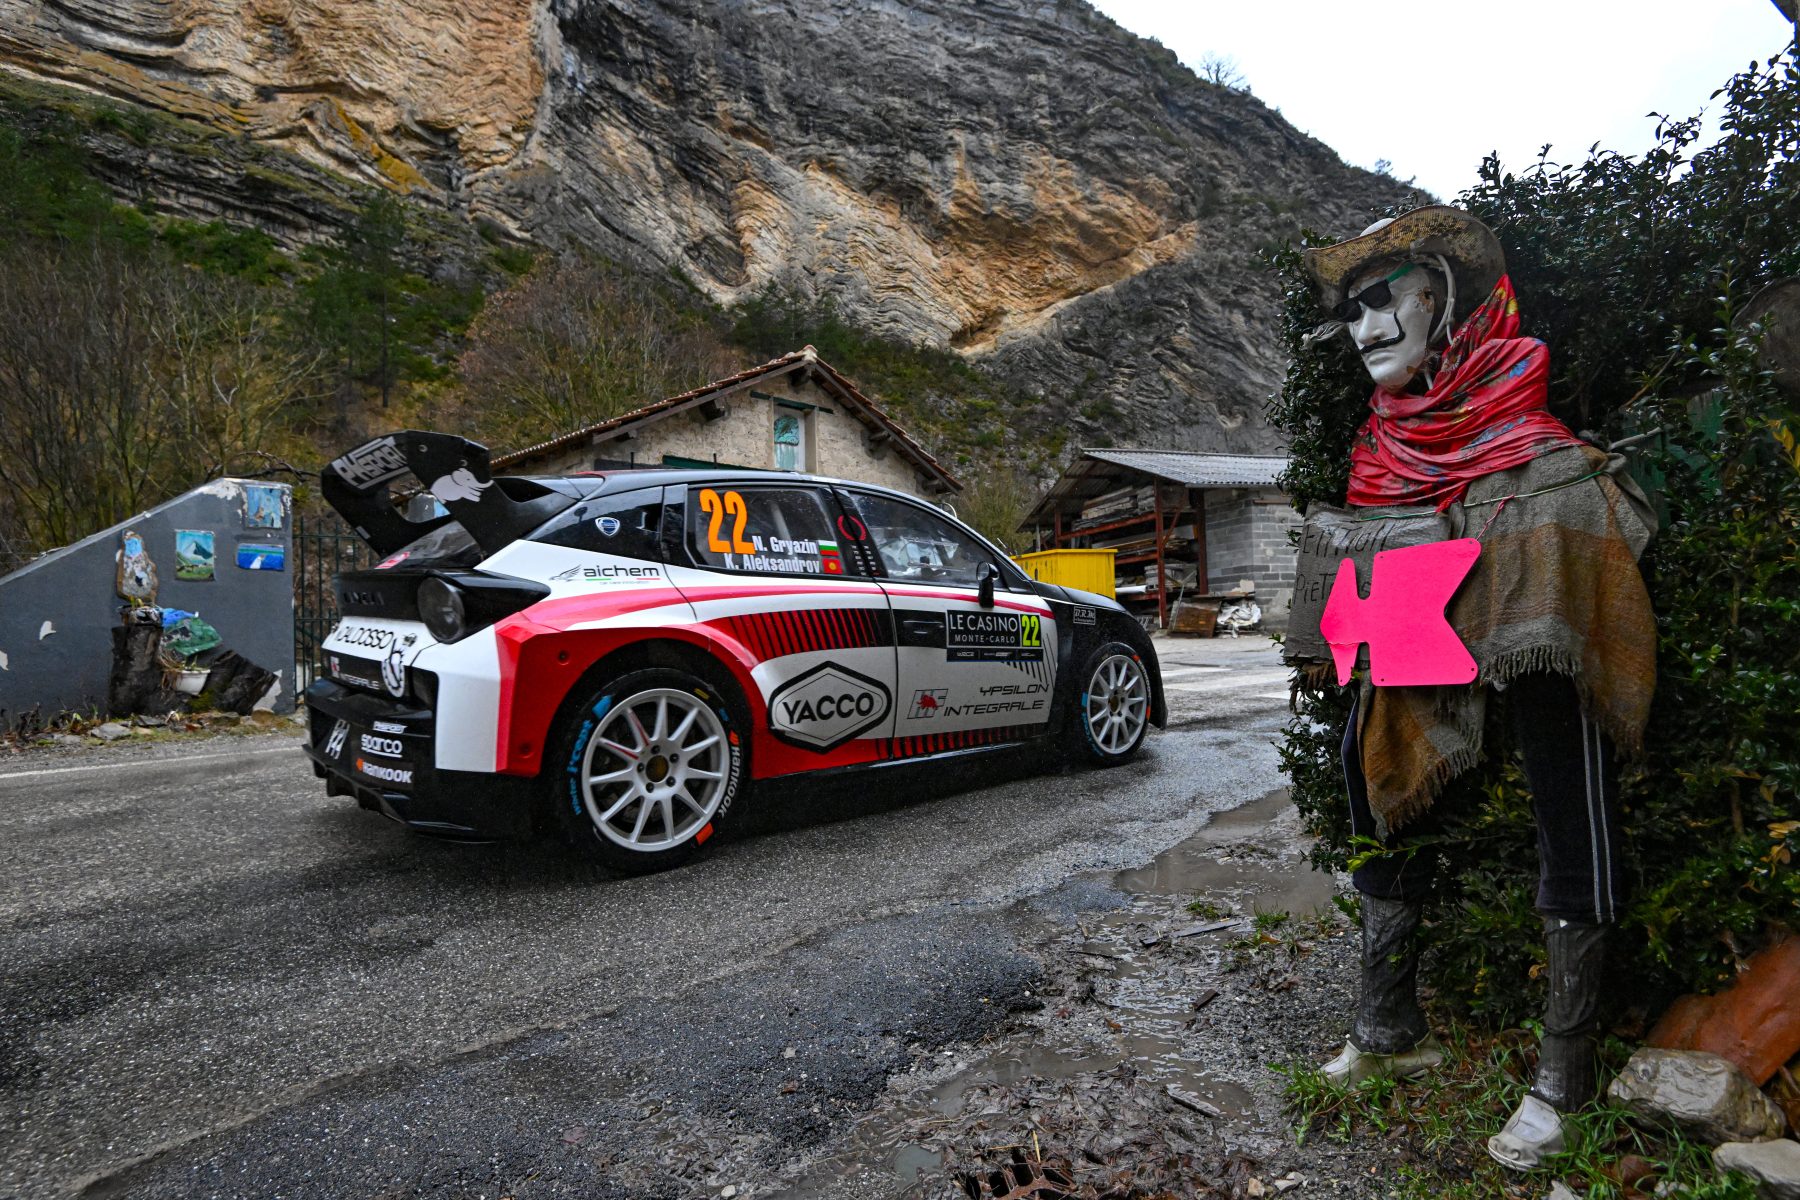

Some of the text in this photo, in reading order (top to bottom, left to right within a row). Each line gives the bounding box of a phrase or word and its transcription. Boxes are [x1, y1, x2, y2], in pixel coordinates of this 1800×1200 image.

[700, 489, 756, 555] 22
[752, 536, 818, 555] N. Gryazin
[584, 565, 660, 577] aichem
[724, 553, 820, 573] K. Aleksandrov
[950, 614, 1018, 632] LE CASINO
[1021, 615, 1040, 646] 22
[980, 684, 1050, 696] YPSILON
[783, 692, 874, 724] YACCO
[944, 700, 1044, 716] INTEGRALE
[361, 733, 403, 754] sparco
